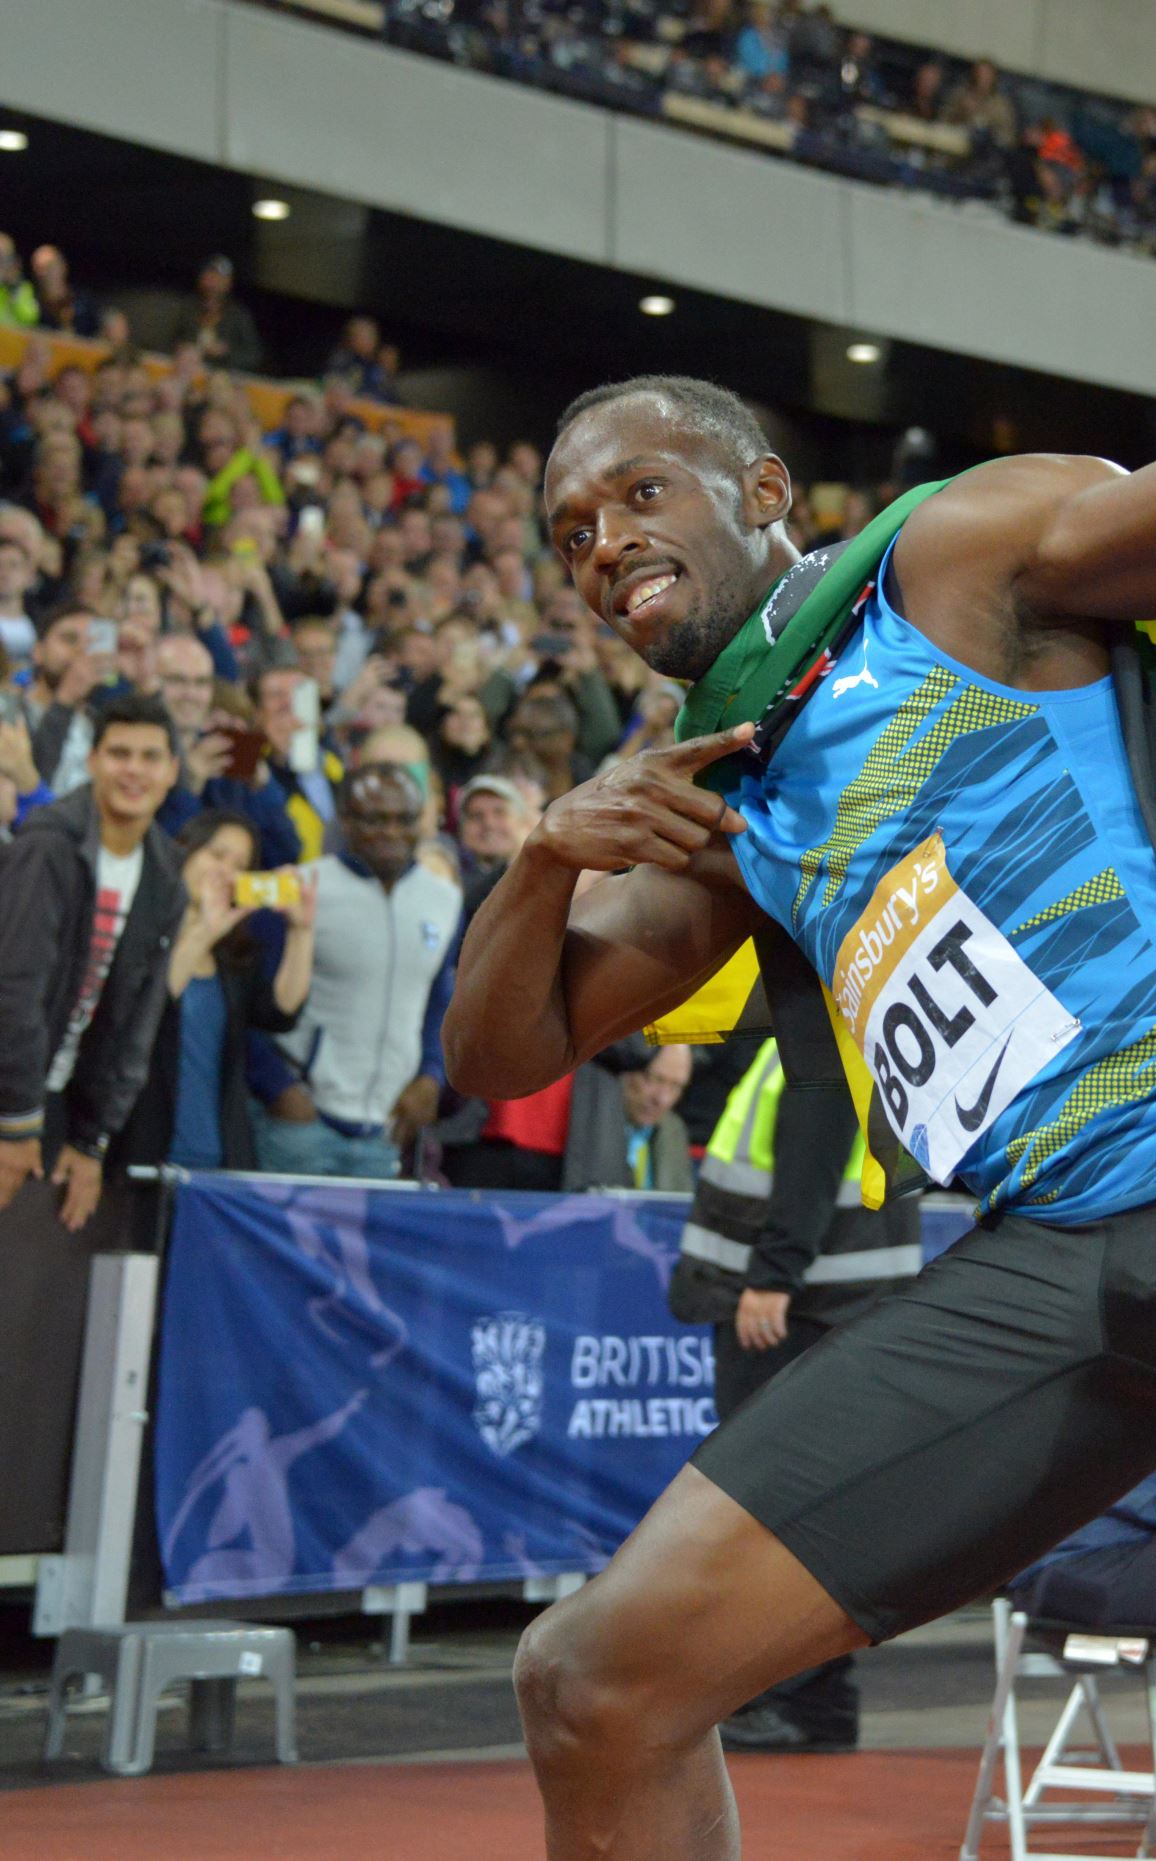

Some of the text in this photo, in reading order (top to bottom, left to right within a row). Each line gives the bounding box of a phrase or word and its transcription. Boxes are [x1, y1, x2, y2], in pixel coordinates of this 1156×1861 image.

[841, 859, 940, 1035] Sainsbury's
[873, 918, 999, 1133] BOLT
[566, 1397, 720, 1439] ATHLETIC
